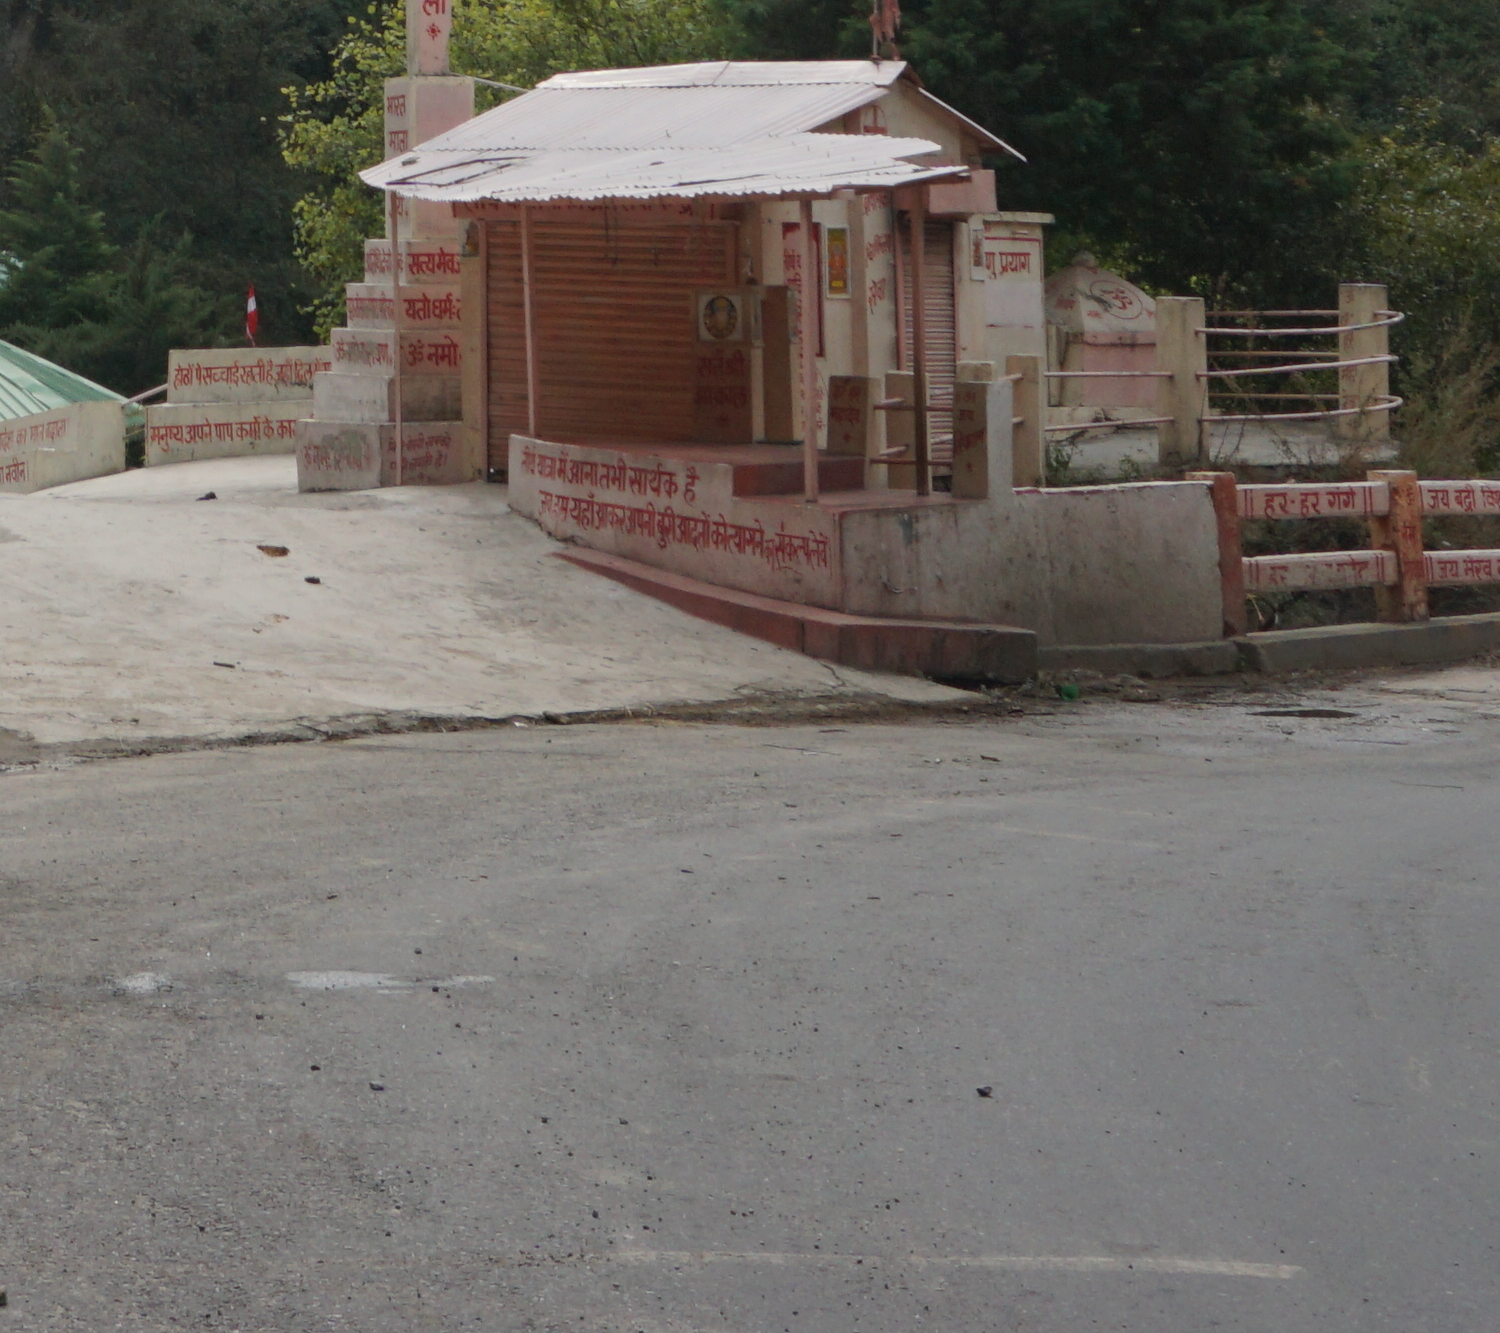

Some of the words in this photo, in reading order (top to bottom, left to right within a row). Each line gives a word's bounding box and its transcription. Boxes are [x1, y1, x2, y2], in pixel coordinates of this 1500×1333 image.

[999, 251, 1031, 277] प्रयाग
[150, 424, 184, 453] मनुष्य
[184, 417, 213, 444] अपने
[214, 421, 234, 443] पाप
[262, 415, 275, 440] के
[567, 459, 599, 487] आना
[599, 458, 627, 492] तभी
[628, 462, 679, 500] सार्थक
[683, 465, 700, 506] है
[1426, 489, 1450, 509] जय
[1437, 559, 1459, 579] जय
